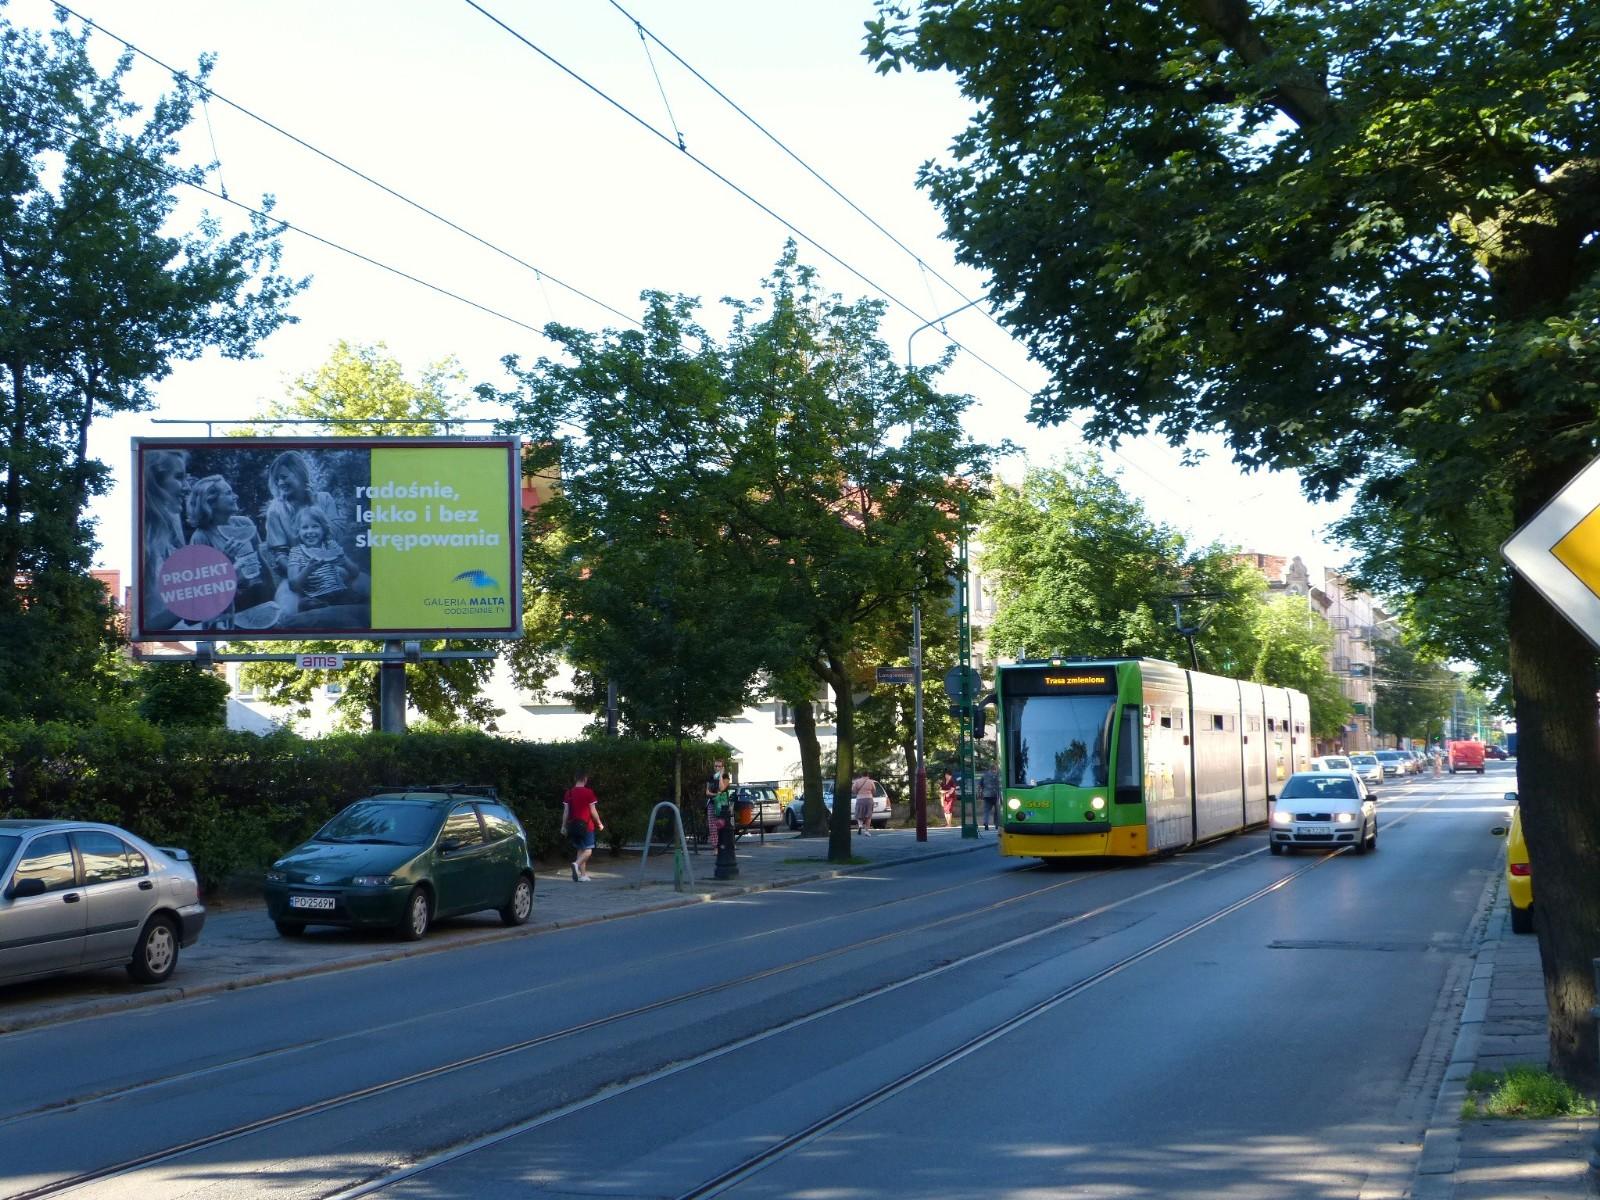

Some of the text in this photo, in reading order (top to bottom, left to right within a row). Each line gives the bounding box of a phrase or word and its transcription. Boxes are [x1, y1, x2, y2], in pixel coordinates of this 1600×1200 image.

[355, 480, 460, 501] radośnie,
[356, 504, 479, 522] lekko i bez
[355, 529, 499, 551] skrępowania
[162, 562, 228, 586] PROJEKT
[160, 579, 236, 603] WEEKEND
[424, 597, 505, 607] GALERIA MALTA
[302, 656, 337, 667] ams
[1044, 676, 1105, 685] Trasa zmieniona
